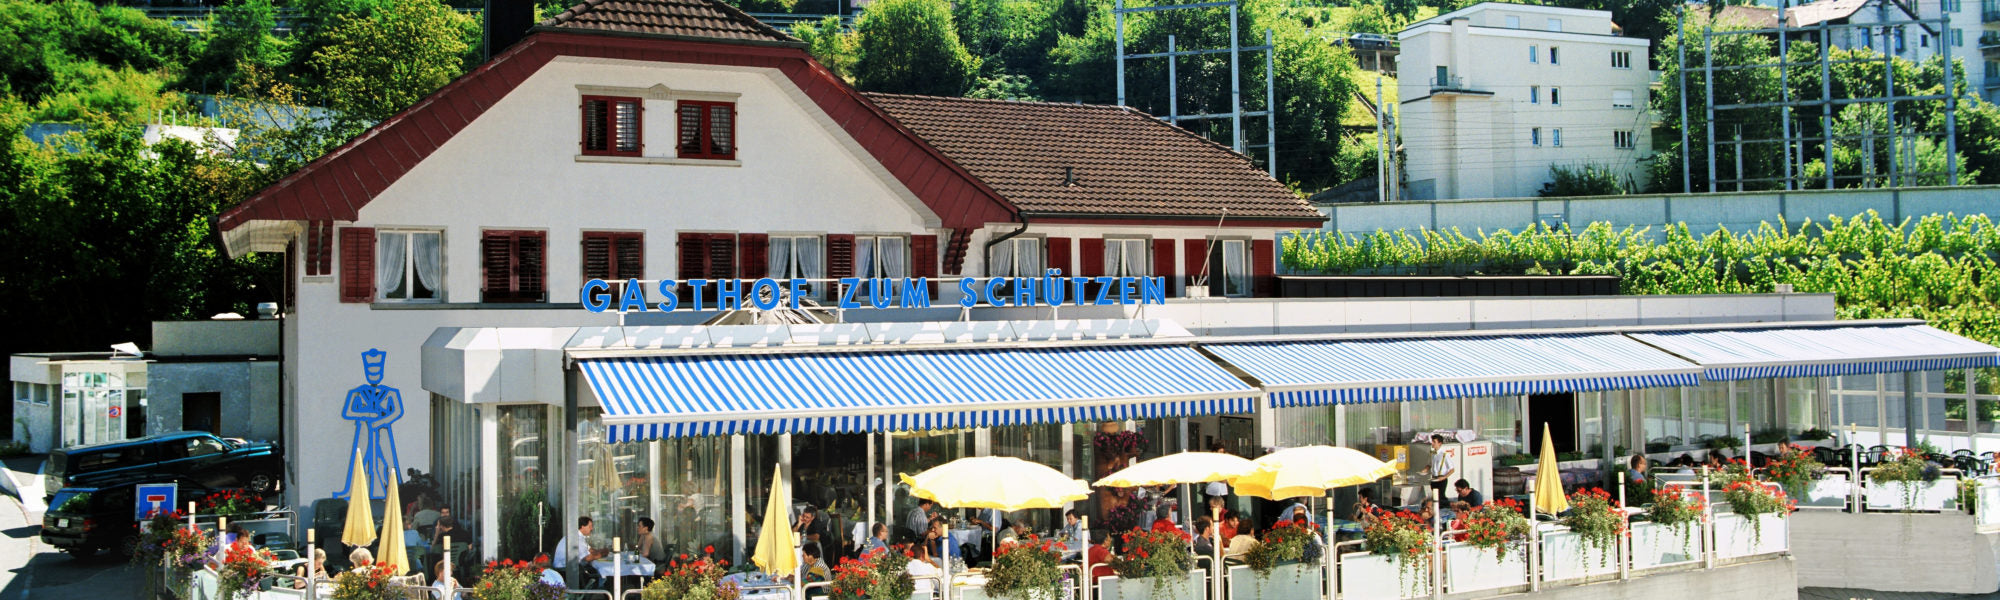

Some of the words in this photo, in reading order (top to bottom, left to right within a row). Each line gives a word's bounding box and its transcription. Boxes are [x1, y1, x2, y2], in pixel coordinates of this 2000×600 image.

[581, 278, 807, 313] GASTHOF
[839, 276, 931, 309] ZUM
[959, 268, 1166, 308] SCHÜTZEN
